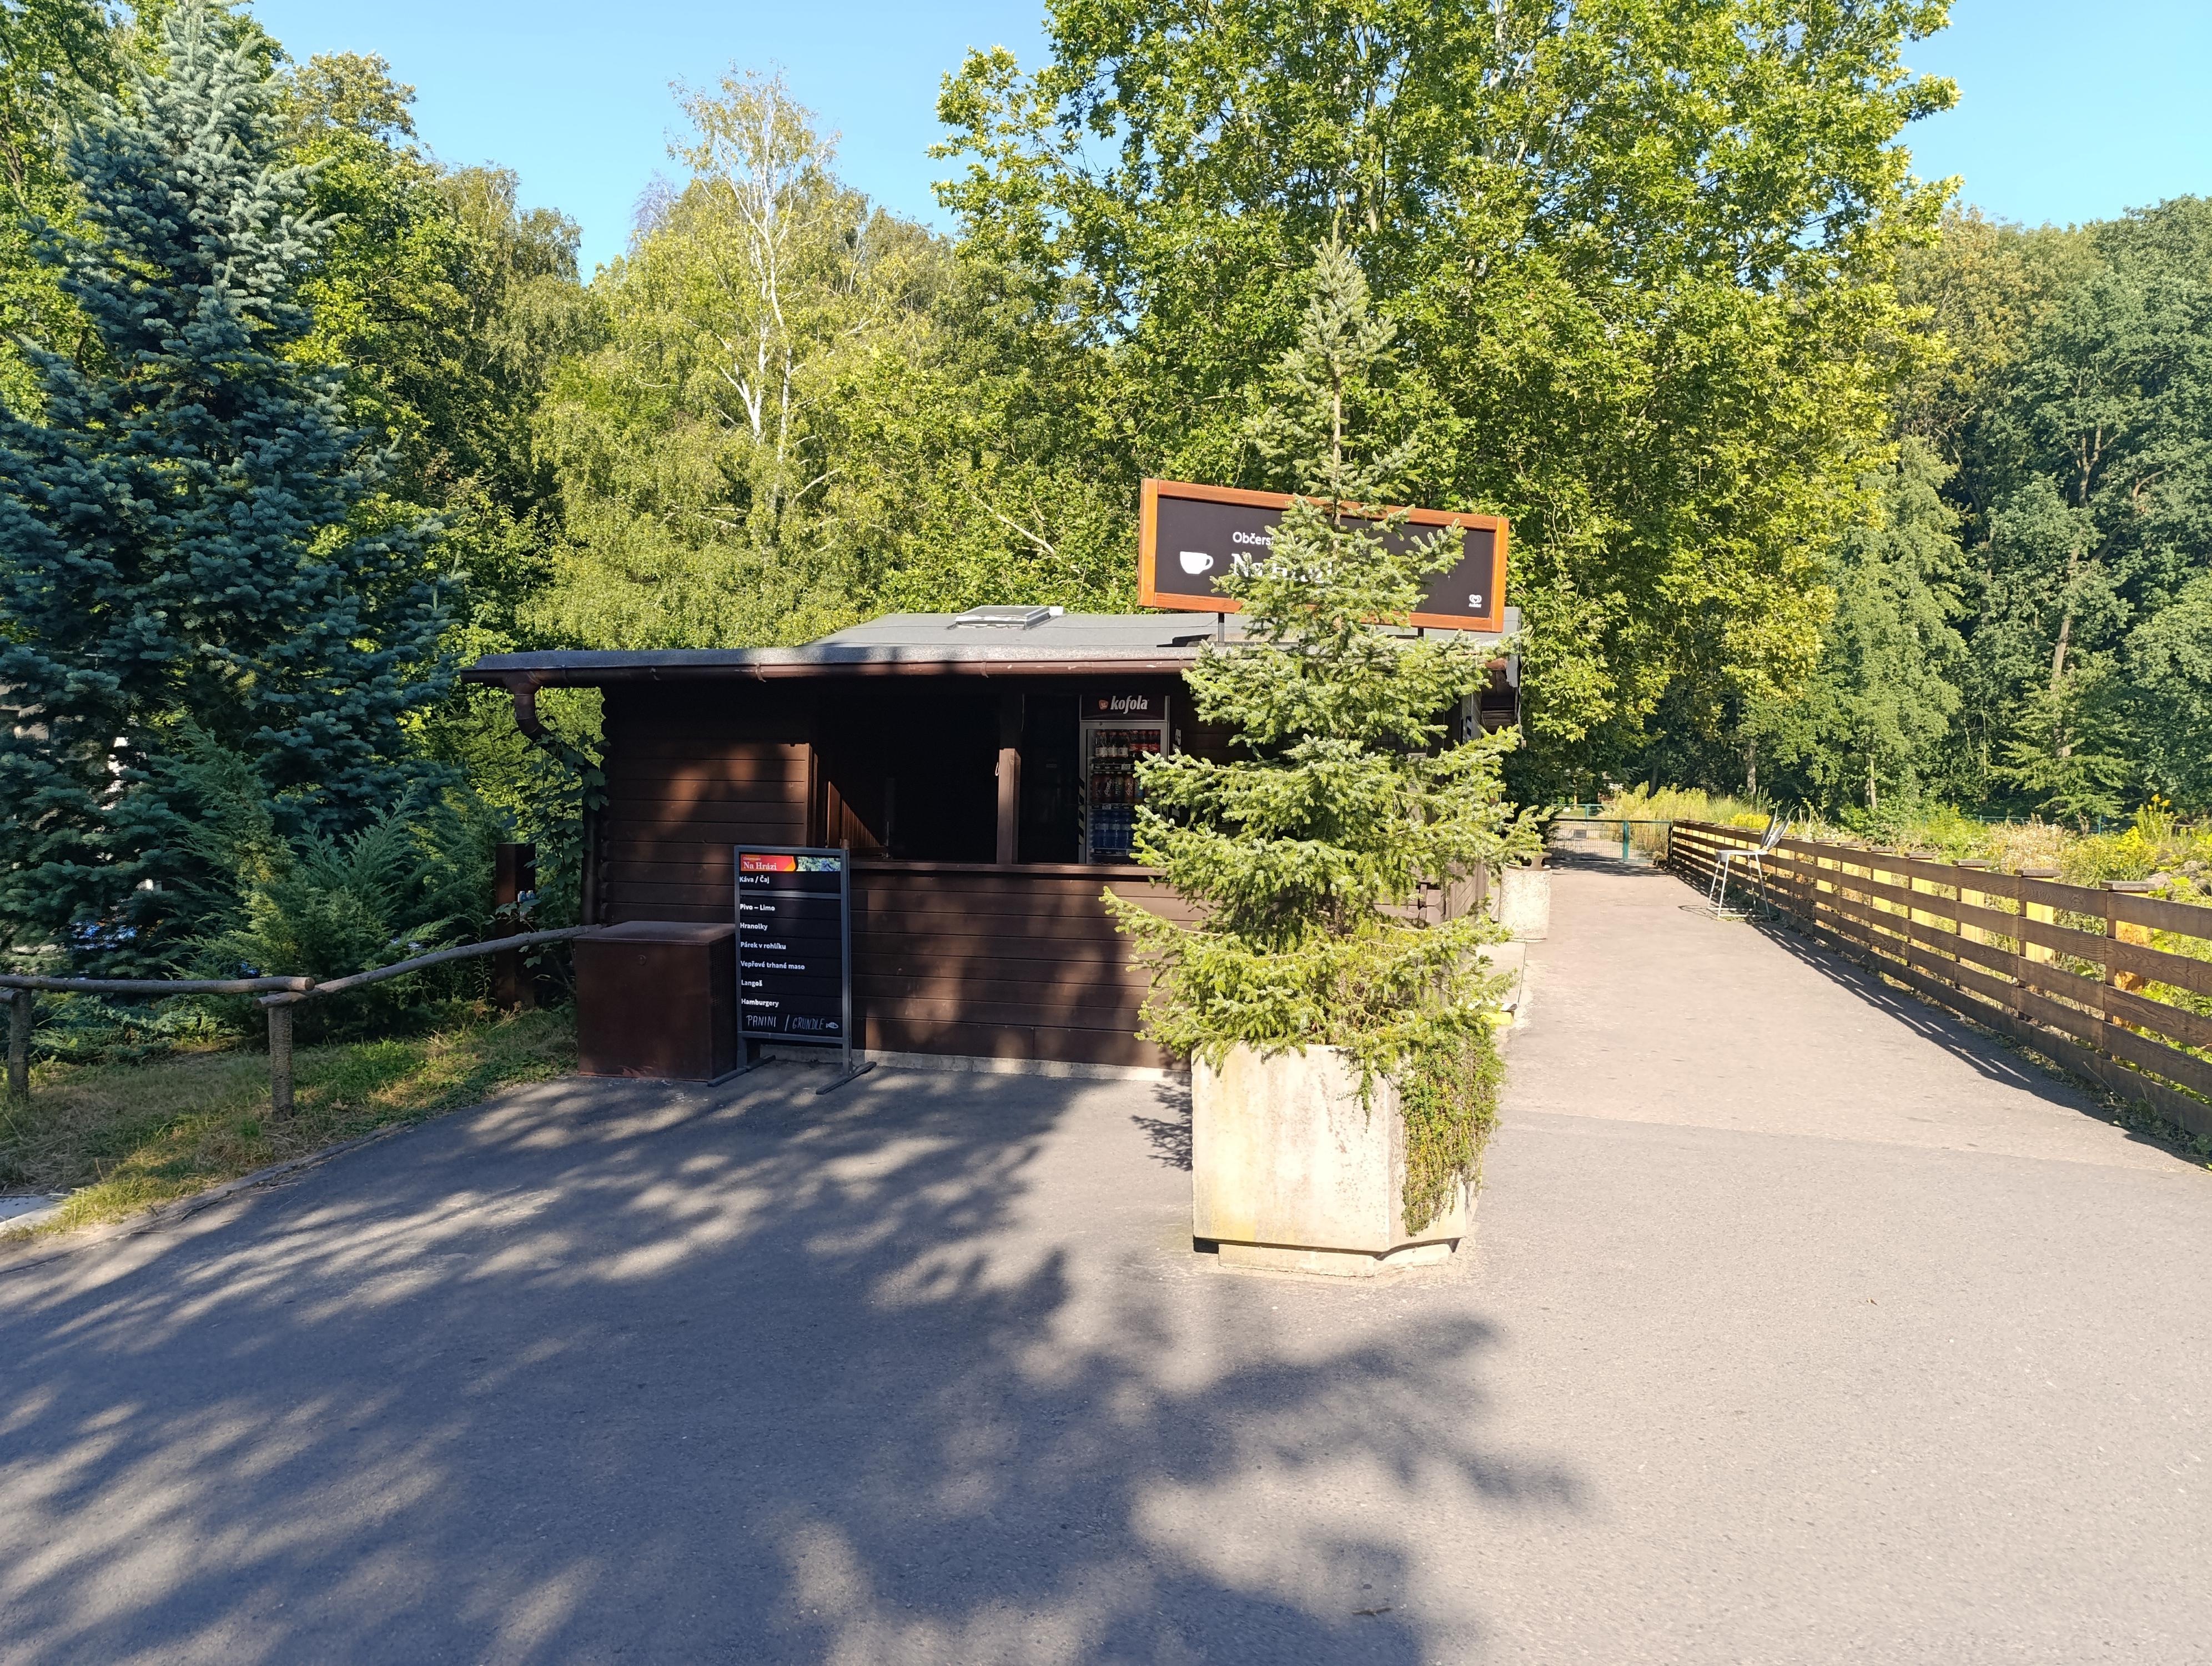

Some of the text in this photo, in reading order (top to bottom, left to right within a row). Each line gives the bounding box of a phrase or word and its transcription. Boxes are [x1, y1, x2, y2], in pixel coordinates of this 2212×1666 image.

[1232, 531, 1278, 546] Občers
[1110, 695, 1148, 714] kofola
[743, 861, 777, 871] Na Hrázi
[760, 874, 770, 884] Čaj
[740, 922, 768, 931] Hranolky
[740, 960, 766, 969] Vepřové
[741, 998, 780, 1008] Hamburgery
[746, 1015, 777, 1027] PANINI
[792, 1016, 825, 1031] GRUNDLE
